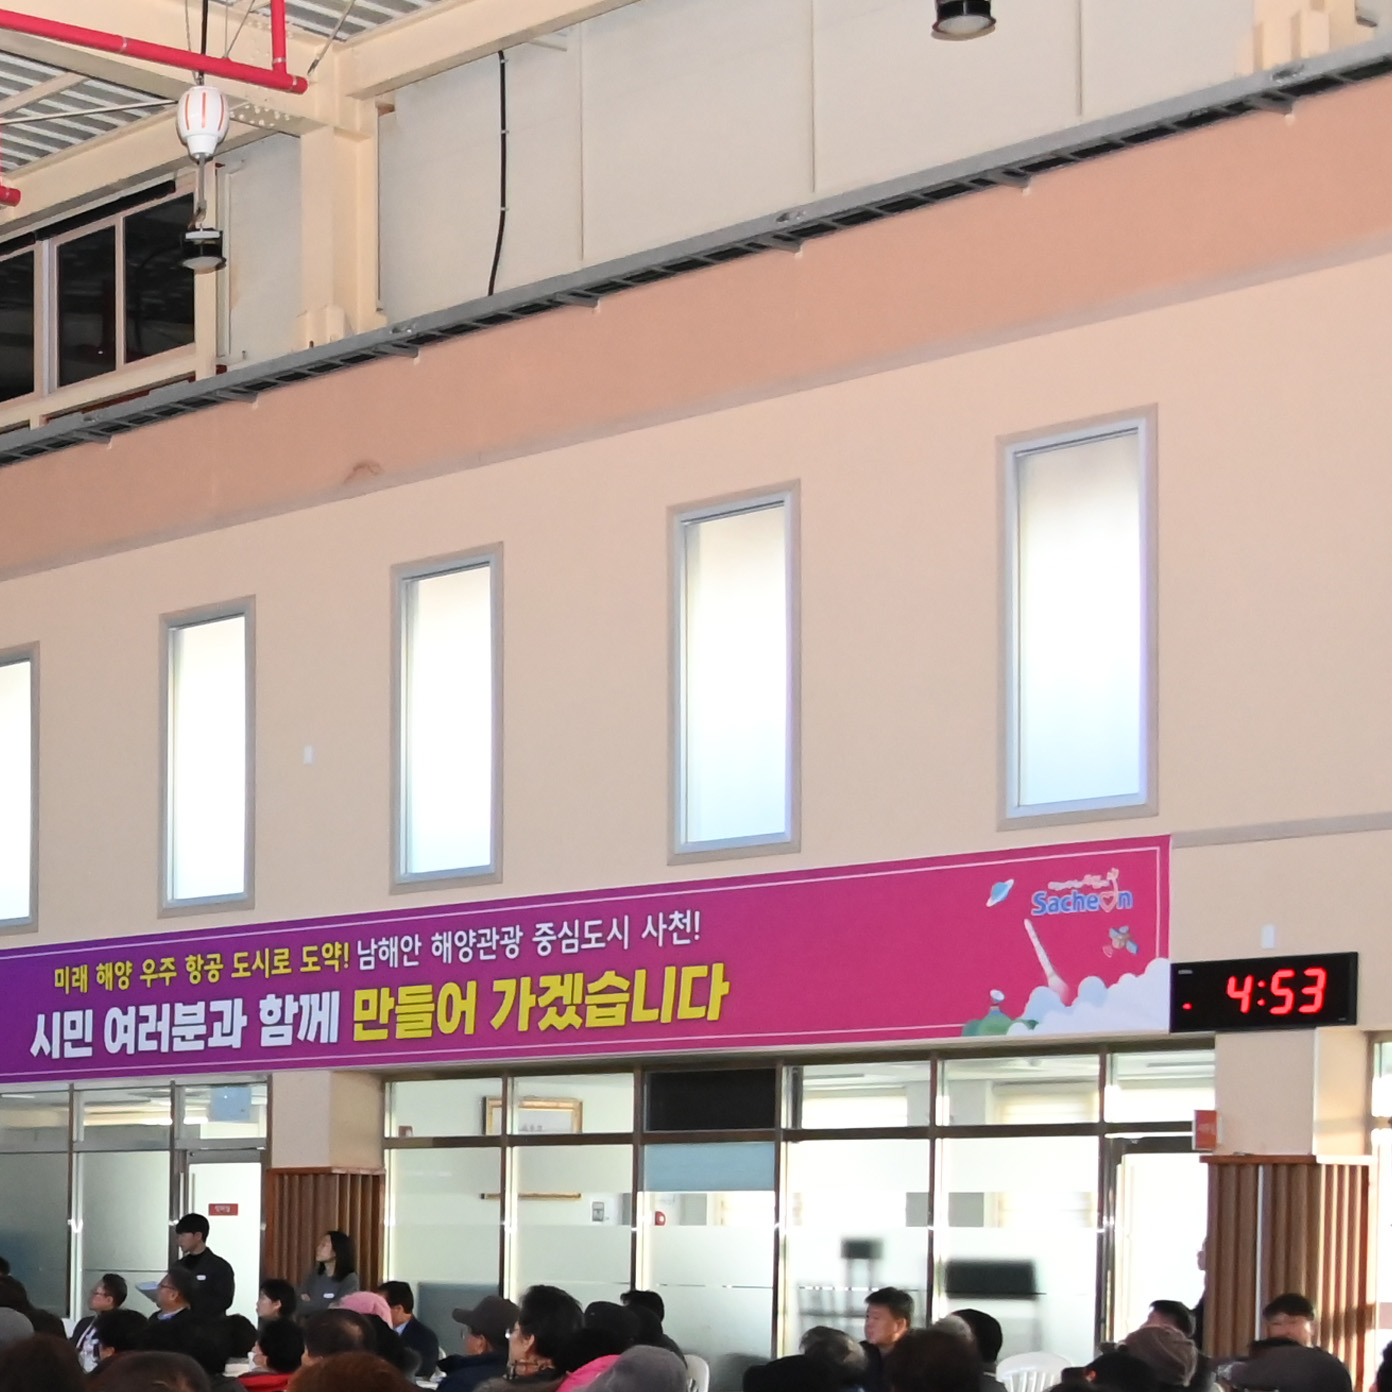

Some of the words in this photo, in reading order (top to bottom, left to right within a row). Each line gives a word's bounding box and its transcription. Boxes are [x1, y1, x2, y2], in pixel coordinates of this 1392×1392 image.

[54, 964, 89, 994] 미래
[96, 960, 133, 992] 해양
[140, 958, 177, 987] 우주
[185, 953, 224, 985] 항공
[231, 948, 292, 978] 도시로
[300, 941, 350, 973] 도약!
[357, 934, 421, 971] 남해안
[431, 925, 524, 964] 해양관광
[532, 915, 629, 957] 중심도시
[641, 910, 701, 947] 사천!
[1226, 967, 1327, 1015] 4:53
[30, 1009, 94, 1059] 시민
[103, 998, 248, 1055] 여러분과
[259, 990, 340, 1047] 함께
[353, 980, 477, 1042] 만들어
[489, 962, 730, 1033] 가겠습니다
